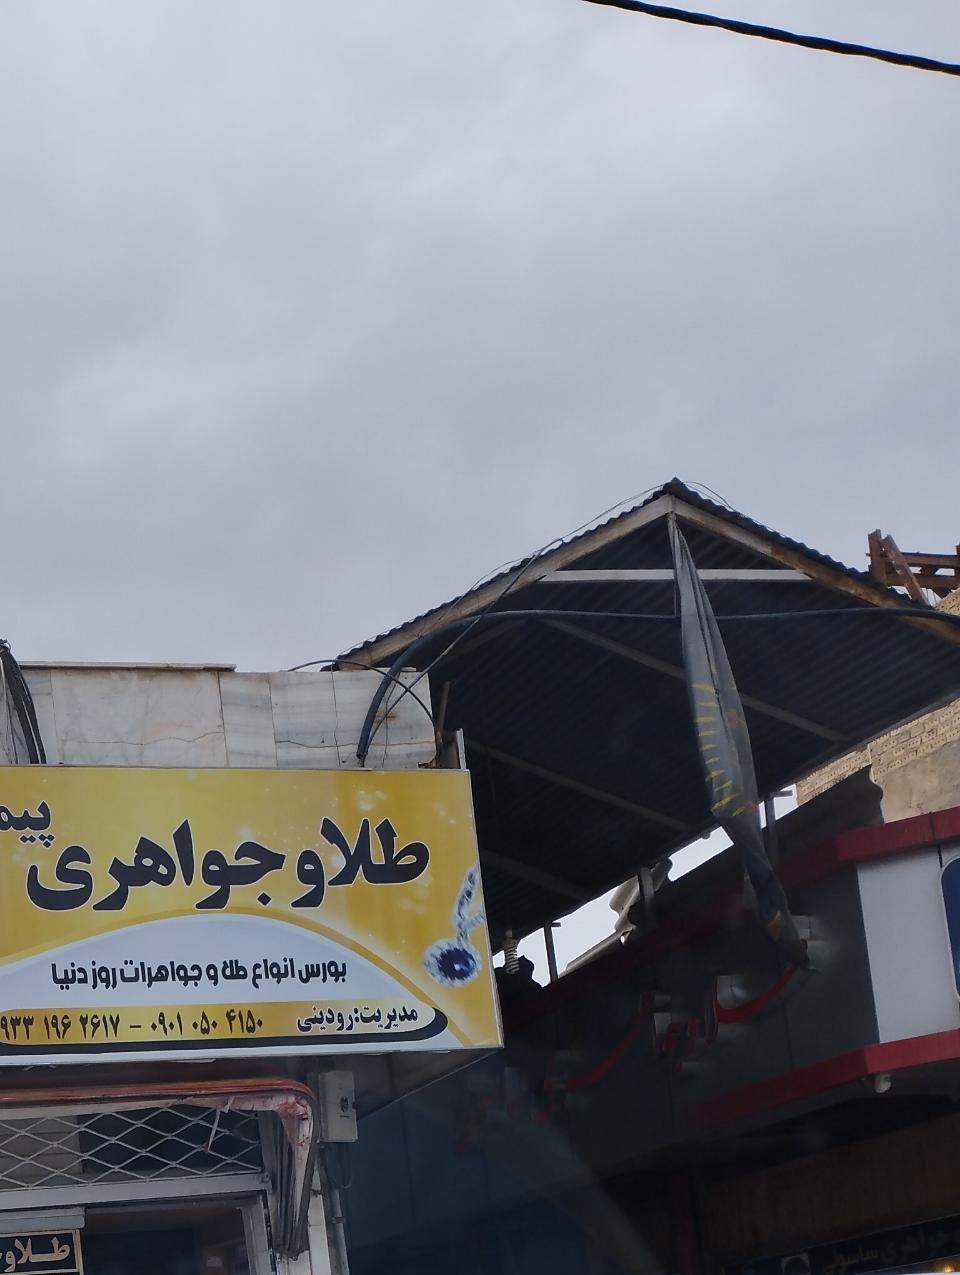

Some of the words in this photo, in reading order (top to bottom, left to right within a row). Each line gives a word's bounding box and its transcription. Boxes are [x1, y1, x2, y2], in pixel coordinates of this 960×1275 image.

[51, 962, 88, 990] دنیا
[90, 961, 118, 990] روز
[120, 959, 203, 988] جواهرات
[221, 959, 248, 980] طلا
[252, 957, 295, 988] انواع
[298, 959, 347, 983] بورس
[43, 1013, 72, 1040] ۱۹۶
[79, 1012, 121, 1040] ۲۶۱۷
[150, 1010, 183, 1036] ۰۹۰۱
[192, 1010, 218, 1036] ۰۵۰
[225, 1007, 264, 1035] ۴۱۵۰
